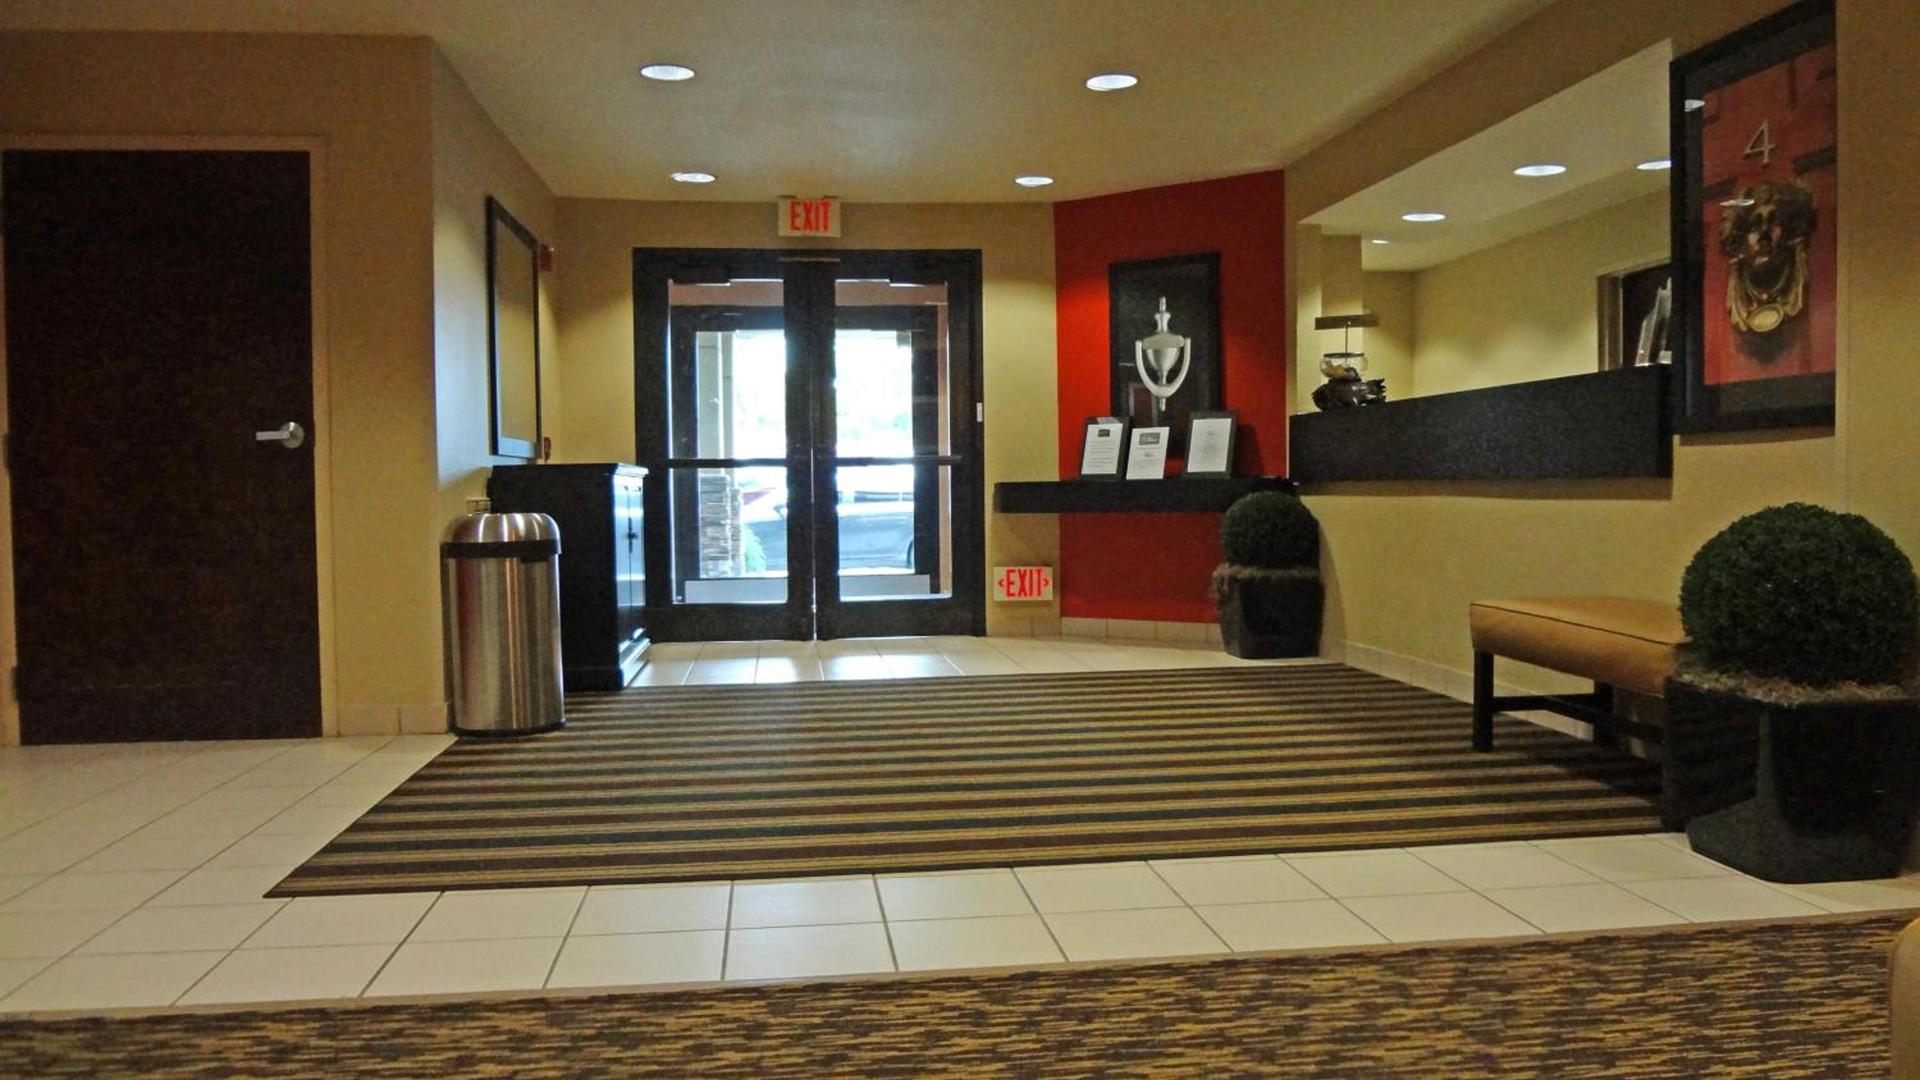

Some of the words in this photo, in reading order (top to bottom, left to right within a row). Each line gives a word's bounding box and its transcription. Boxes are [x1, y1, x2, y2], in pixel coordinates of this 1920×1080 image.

[1744, 118, 1776, 164] 4
[790, 200, 831, 233] EXIT
[1006, 568, 1044, 597] EXIT
